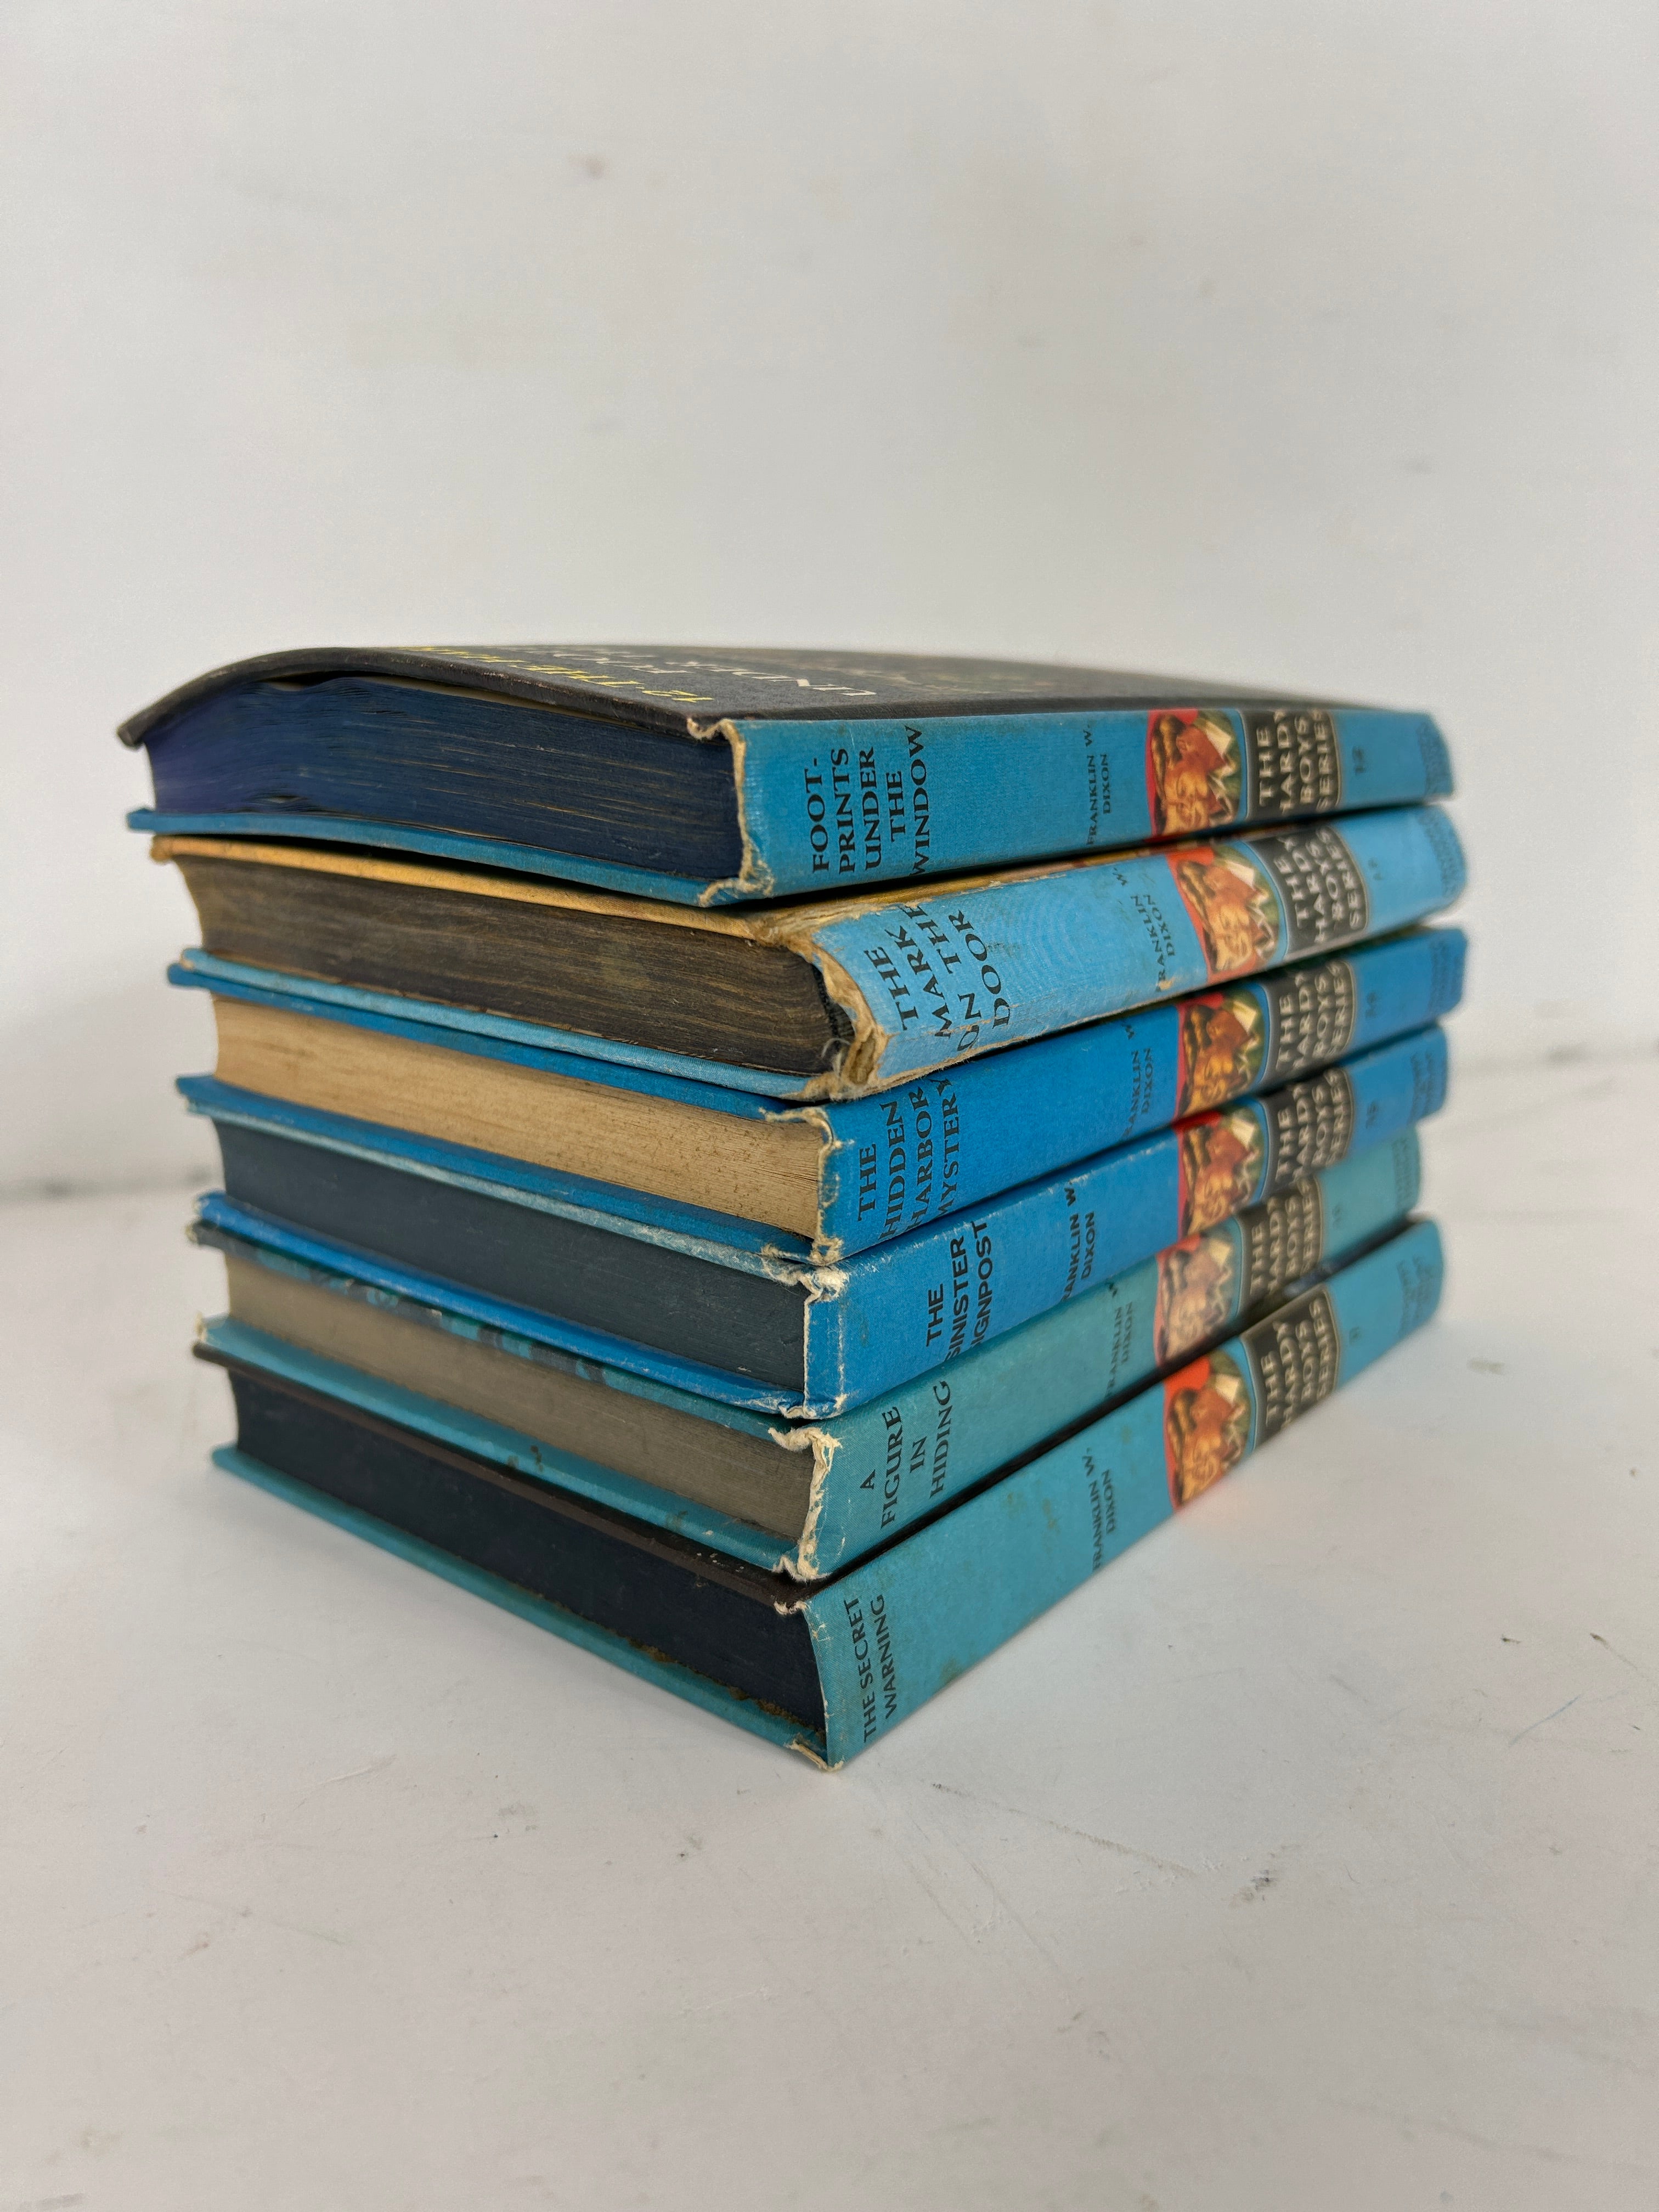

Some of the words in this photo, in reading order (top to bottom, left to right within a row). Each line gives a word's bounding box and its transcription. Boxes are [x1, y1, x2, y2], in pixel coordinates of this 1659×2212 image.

[665, 661, 877, 696] UNDER
[905, 725, 930, 876] WINDOW
[1086, 755, 1098, 845] FRANKLIN
[1100, 753, 1111, 814] DIXON
[1256, 725, 1274, 806] THE
[1294, 715, 1314, 804] BOYS
[1312, 709, 1333, 811] SERIES
[804, 758, 829, 873] FOOT-
[831, 748, 856, 875] PRINTS
[859, 747, 882, 870] UNDER
[886, 770, 906, 842] THE
[1273, 855, 1310, 928] THE
[1277, 836, 1328, 944] HARDY
[1305, 839, 1346, 922] BOYS
[1316, 828, 1361, 929] SERIES
[900, 904, 961, 974] THE
[1143, 894, 1175, 957] DIXON
[864, 946, 918, 1031] THE
[884, 925, 951, 1038] MARK
[949, 909, 1010, 1029] DOOR
[957, 992, 982, 1052] ON
[1276, 993, 1296, 1071] THE
[1312, 973, 1333, 1058] BOYS
[1141, 1047, 1152, 1115] DIXON
[908, 1086, 933, 1229] HARBOR
[1275, 1105, 1296, 1181] THE
[1311, 1084, 1332, 1167] BOYS
[857, 1143, 877, 1222] THE
[879, 1101, 906, 1239] HIDDEN
[1081, 1212, 1095, 1279] DIXON
[1250, 1222, 1267, 1295] THE
[1285, 1195, 1301, 1277] BOYS
[926, 1283, 944, 1347] THE
[969, 1221, 994, 1347] IGNPOST
[1121, 1301, 1133, 1366] DIXON
[1295, 1319, 1318, 1403] BOYS
[1260, 1351, 1284, 1427] THE
[860, 1469, 876, 1490] A
[881, 1406, 905, 1530] FIGURE
[910, 1436, 928, 1474] IN
[930, 1380, 952, 1499] HIDING
[1101, 1469, 1116, 1534] DIXON
[843, 1598, 874, 1690] SECRET
[870, 1594, 898, 1719] WARNING
[864, 1694, 877, 1743] THE
